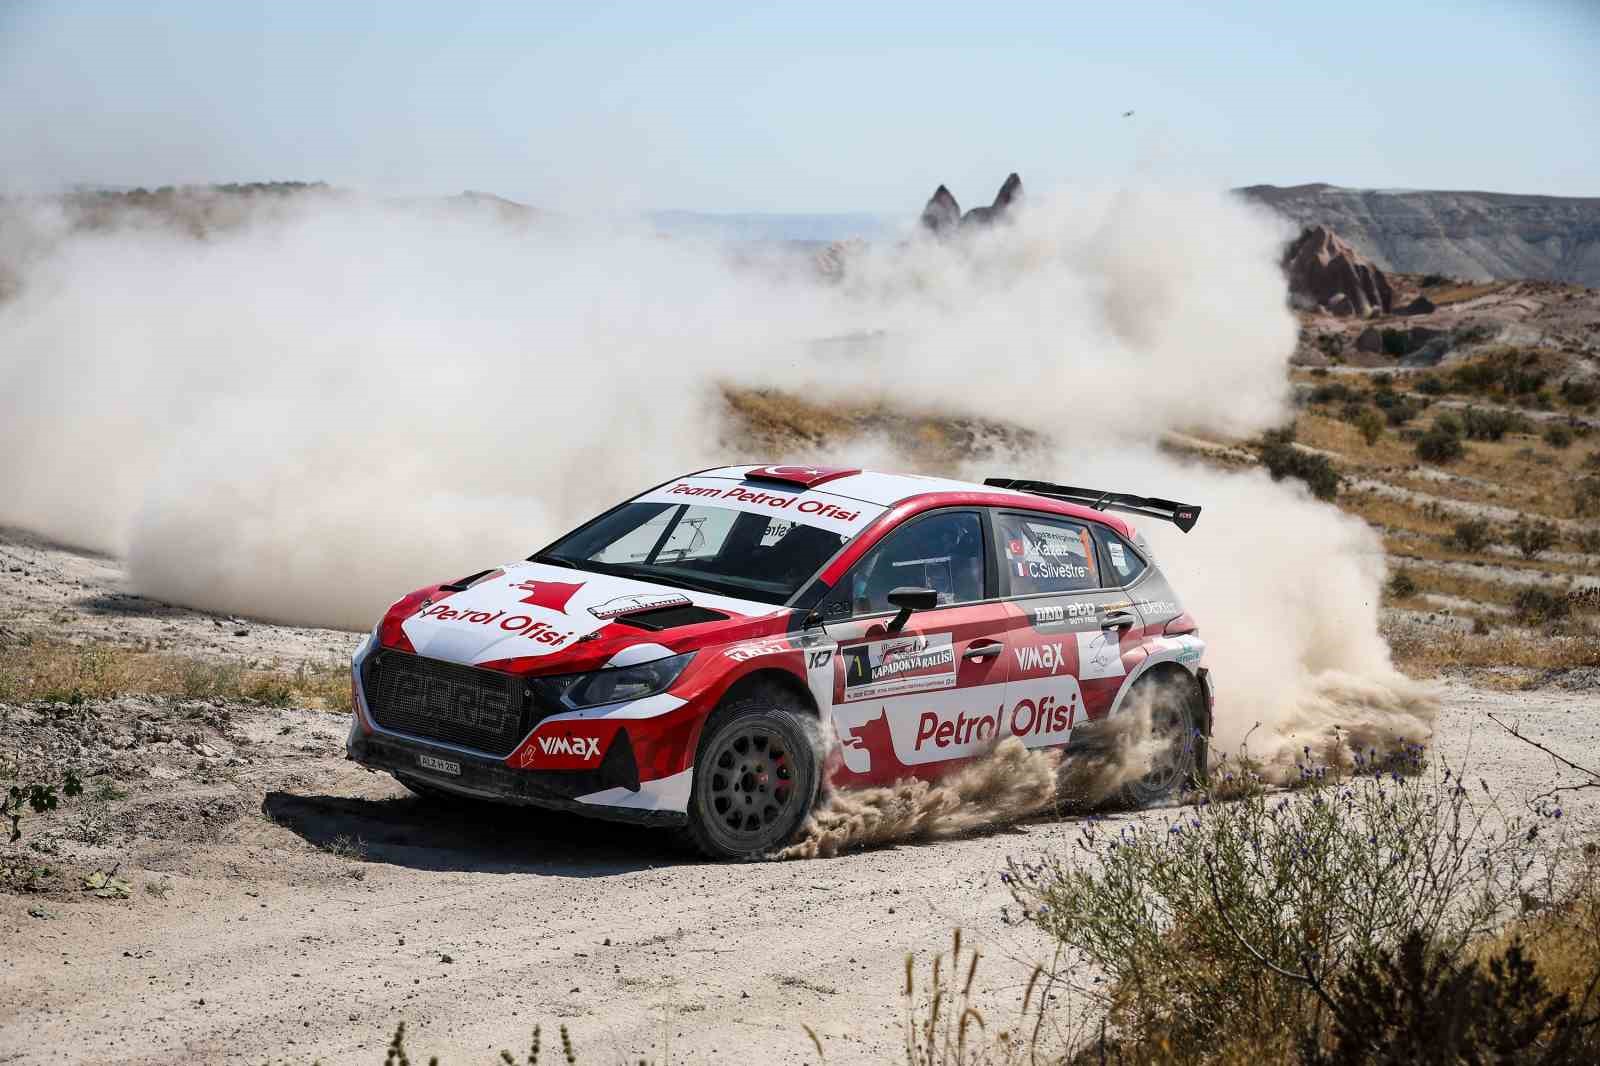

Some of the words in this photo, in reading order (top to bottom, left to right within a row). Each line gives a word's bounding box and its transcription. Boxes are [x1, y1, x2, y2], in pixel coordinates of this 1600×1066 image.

[667, 483, 722, 498] Team
[721, 487, 798, 508] Petrol
[798, 501, 861, 521] Ofisi
[1029, 561, 1085, 578] C.Silvestre
[426, 604, 505, 625] Petrol
[500, 615, 574, 646] Ofisi
[854, 655, 863, 677] 1
[871, 655, 921, 680] KAPADOKYA
[914, 703, 1004, 751] Petrol
[1010, 693, 1077, 737] Ofisi
